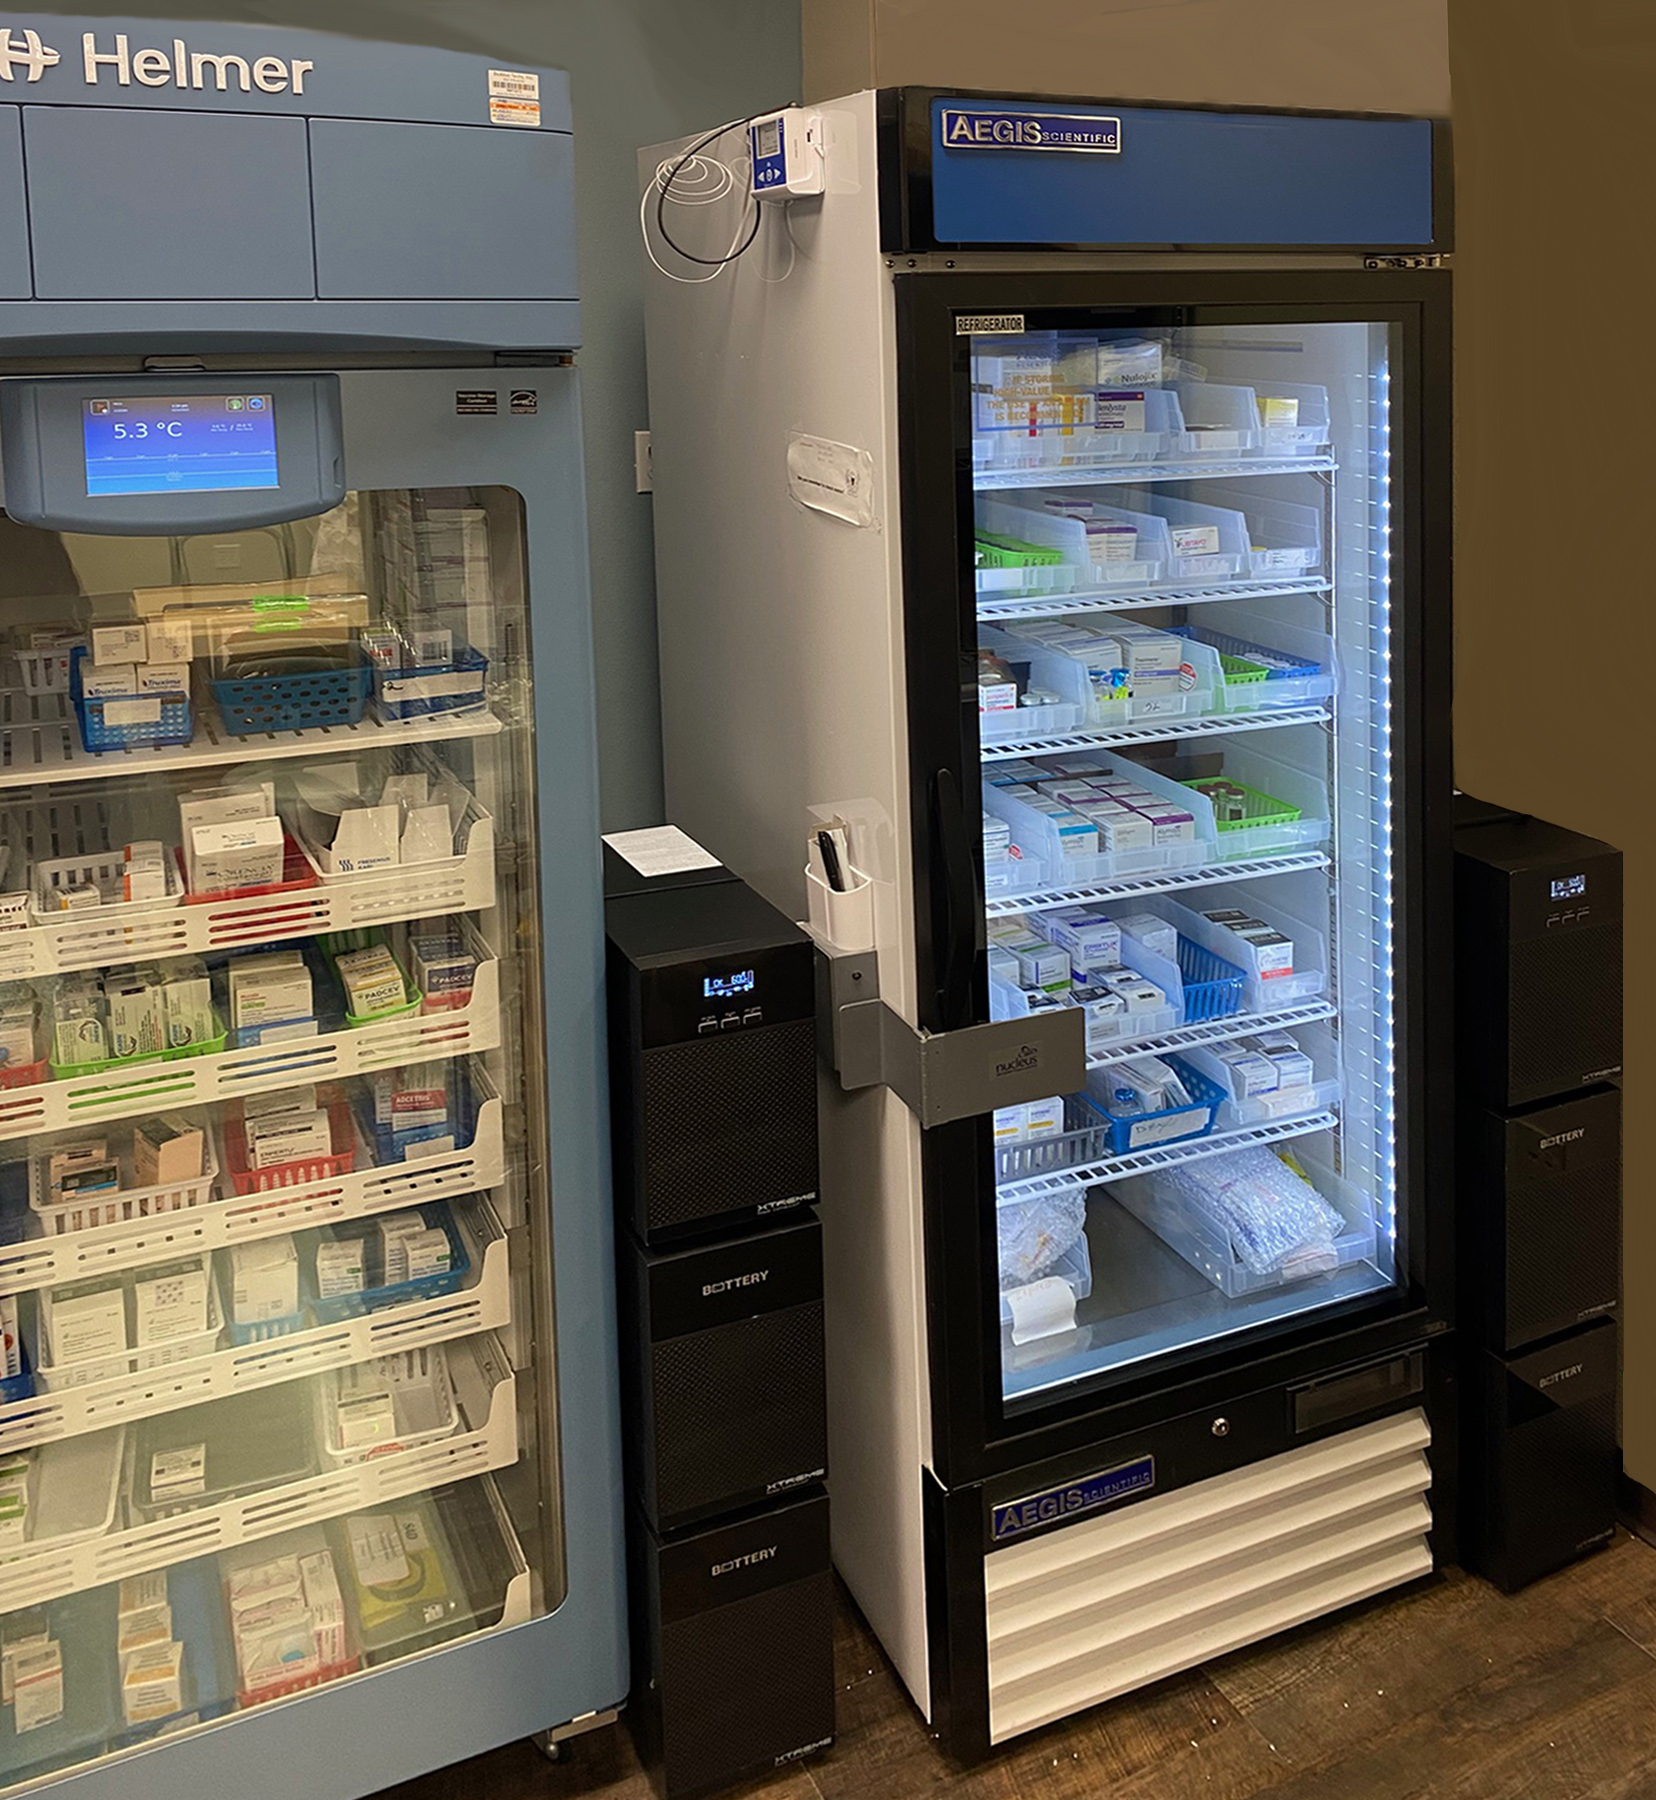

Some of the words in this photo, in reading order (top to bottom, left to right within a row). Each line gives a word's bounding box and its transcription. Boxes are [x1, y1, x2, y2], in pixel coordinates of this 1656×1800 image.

[83, 32, 314, 95] Helmer
[949, 115, 1042, 145] AEGIS
[1041, 131, 1116, 143] SCIENTIFIC
[958, 316, 1023, 332] REFRIGERATOR
[114, 423, 148, 439] 5.3
[157, 421, 182, 437] °C
[365, 985, 400, 1000] PADCEV
[996, 1056, 1038, 1074] nucleus
[757, 1191, 816, 1213] XTREME
[766, 1467, 825, 1492] XTREME
[998, 1488, 1082, 1533] AEGIS
[1083, 1471, 1152, 1501] SCIENTIFIC
